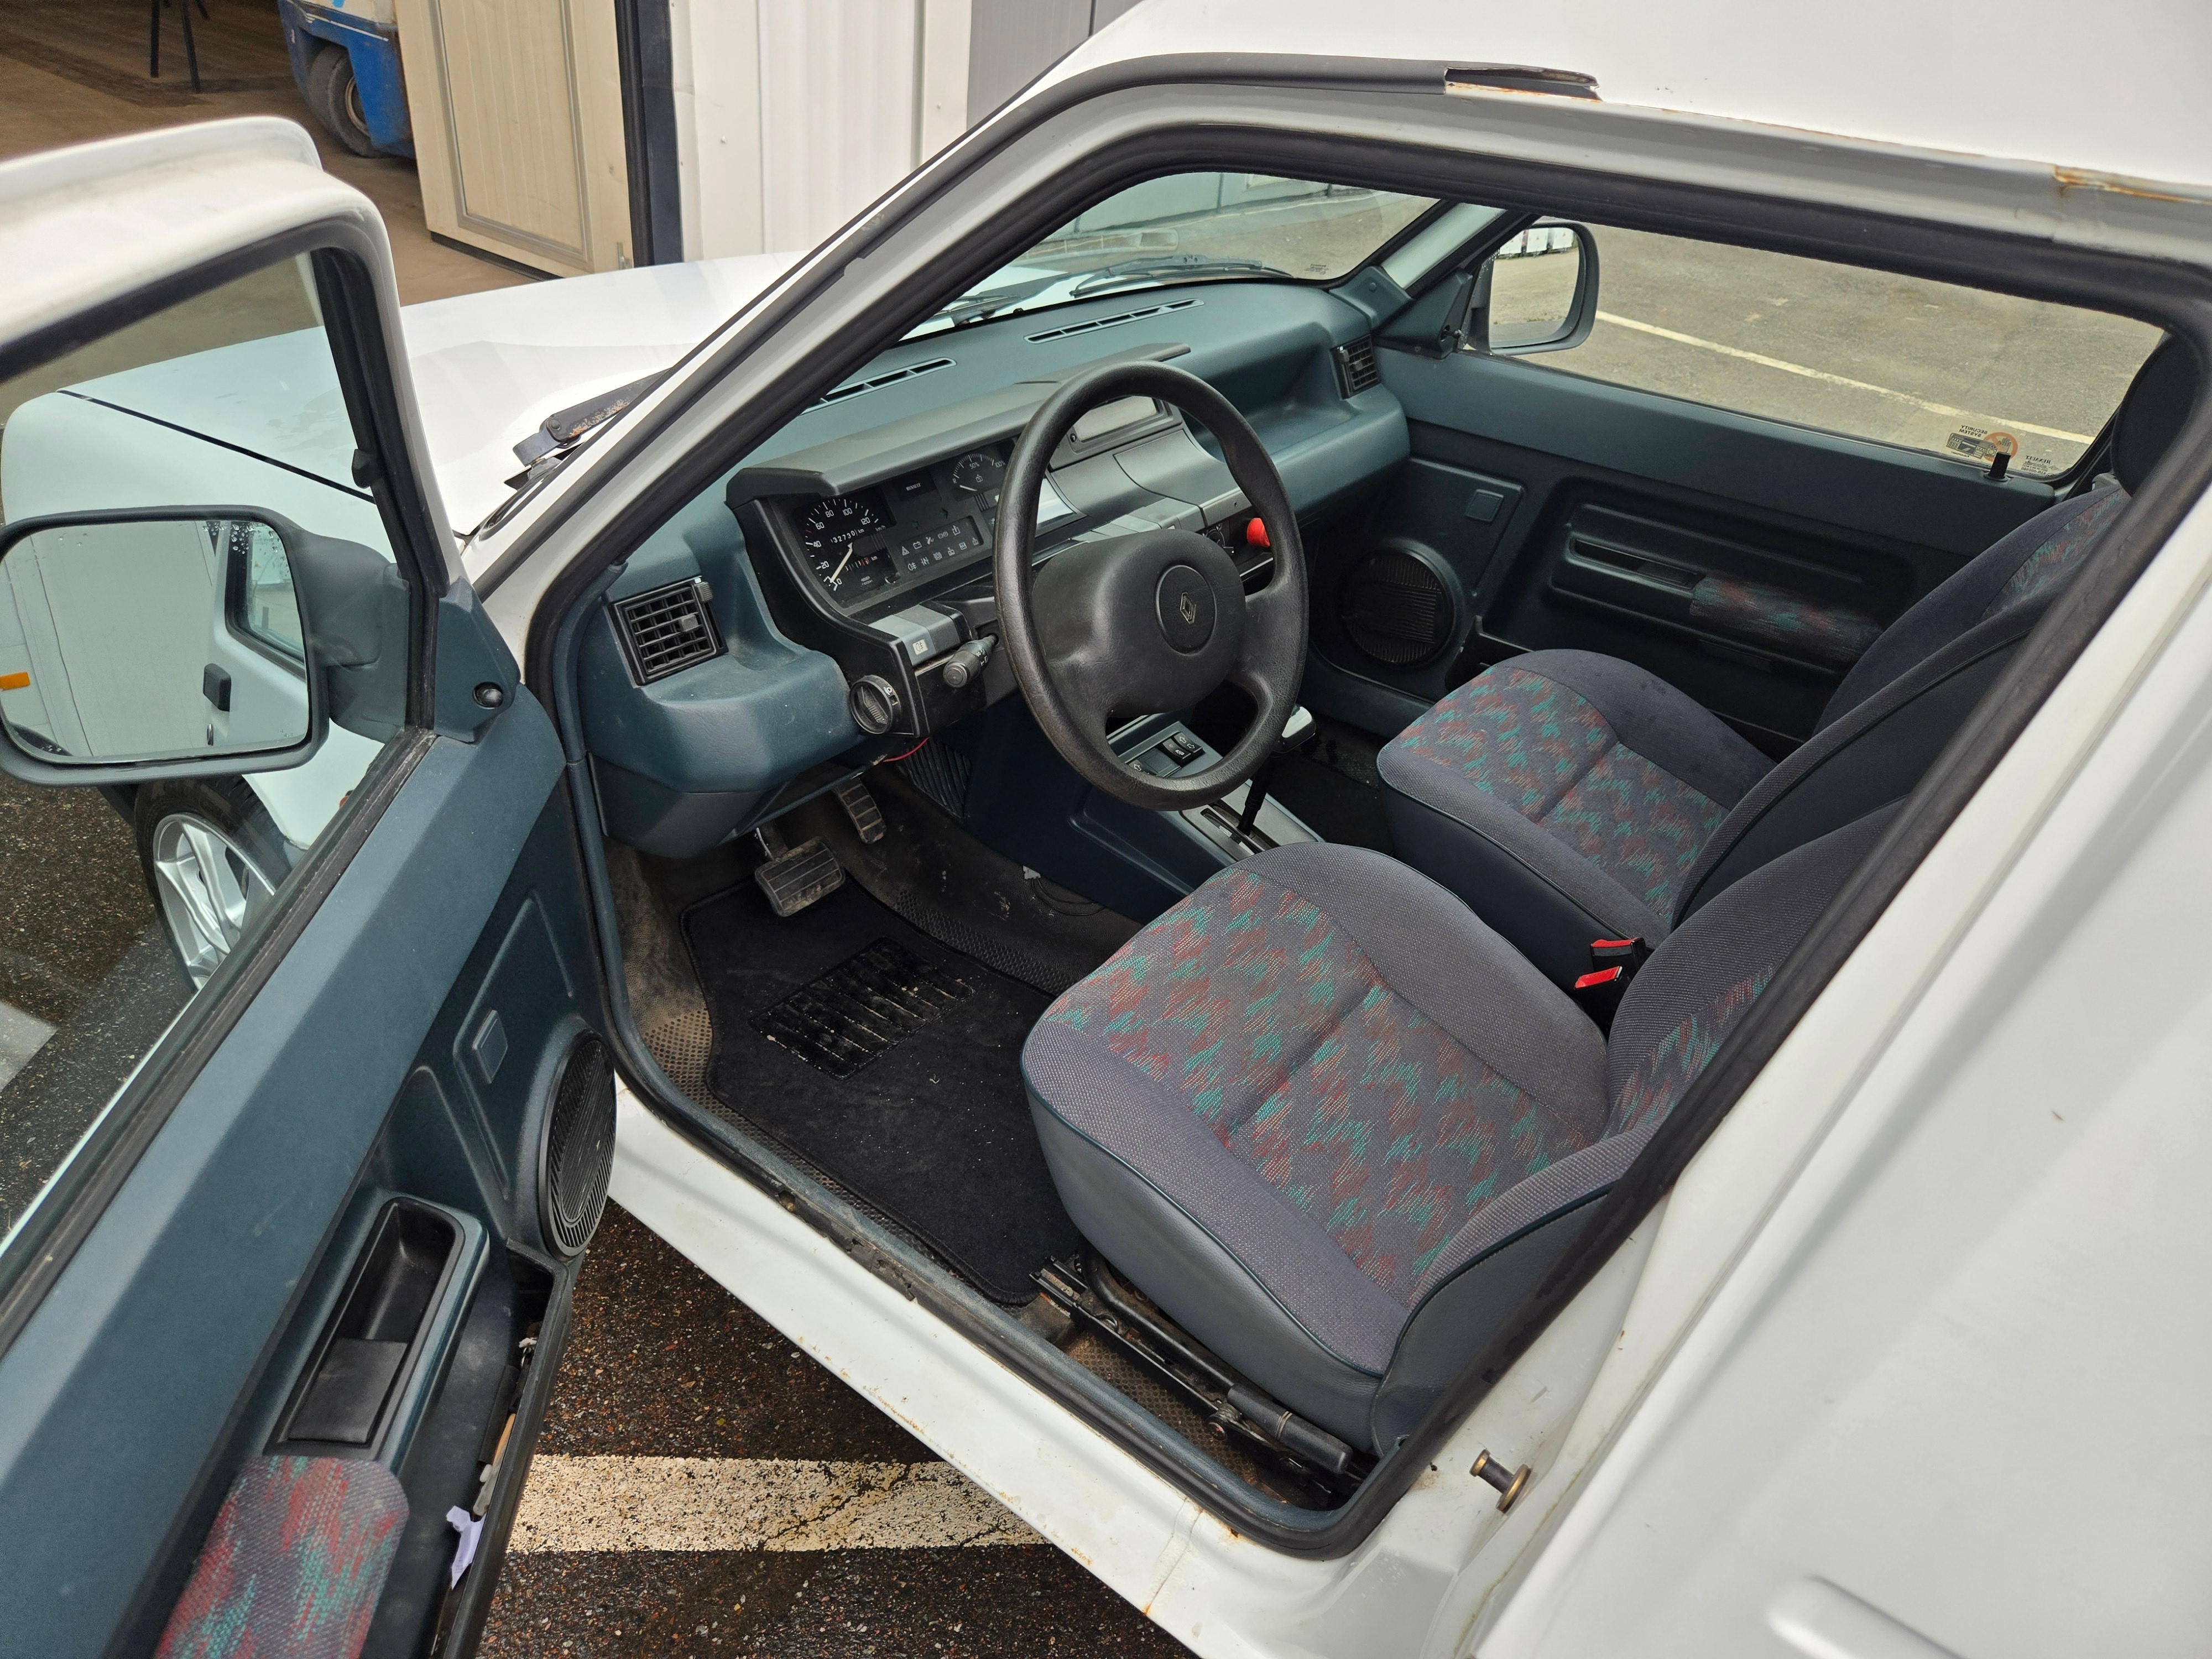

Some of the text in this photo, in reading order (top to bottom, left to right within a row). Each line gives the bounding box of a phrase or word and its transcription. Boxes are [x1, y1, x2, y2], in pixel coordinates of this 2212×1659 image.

[994, 460, 1006, 468] 100%
[825, 509, 834, 518] 80
[842, 508, 853, 516] 100
[860, 517, 871, 525] 120
[815, 521, 825, 530] 60
[820, 561, 830, 569] 20
